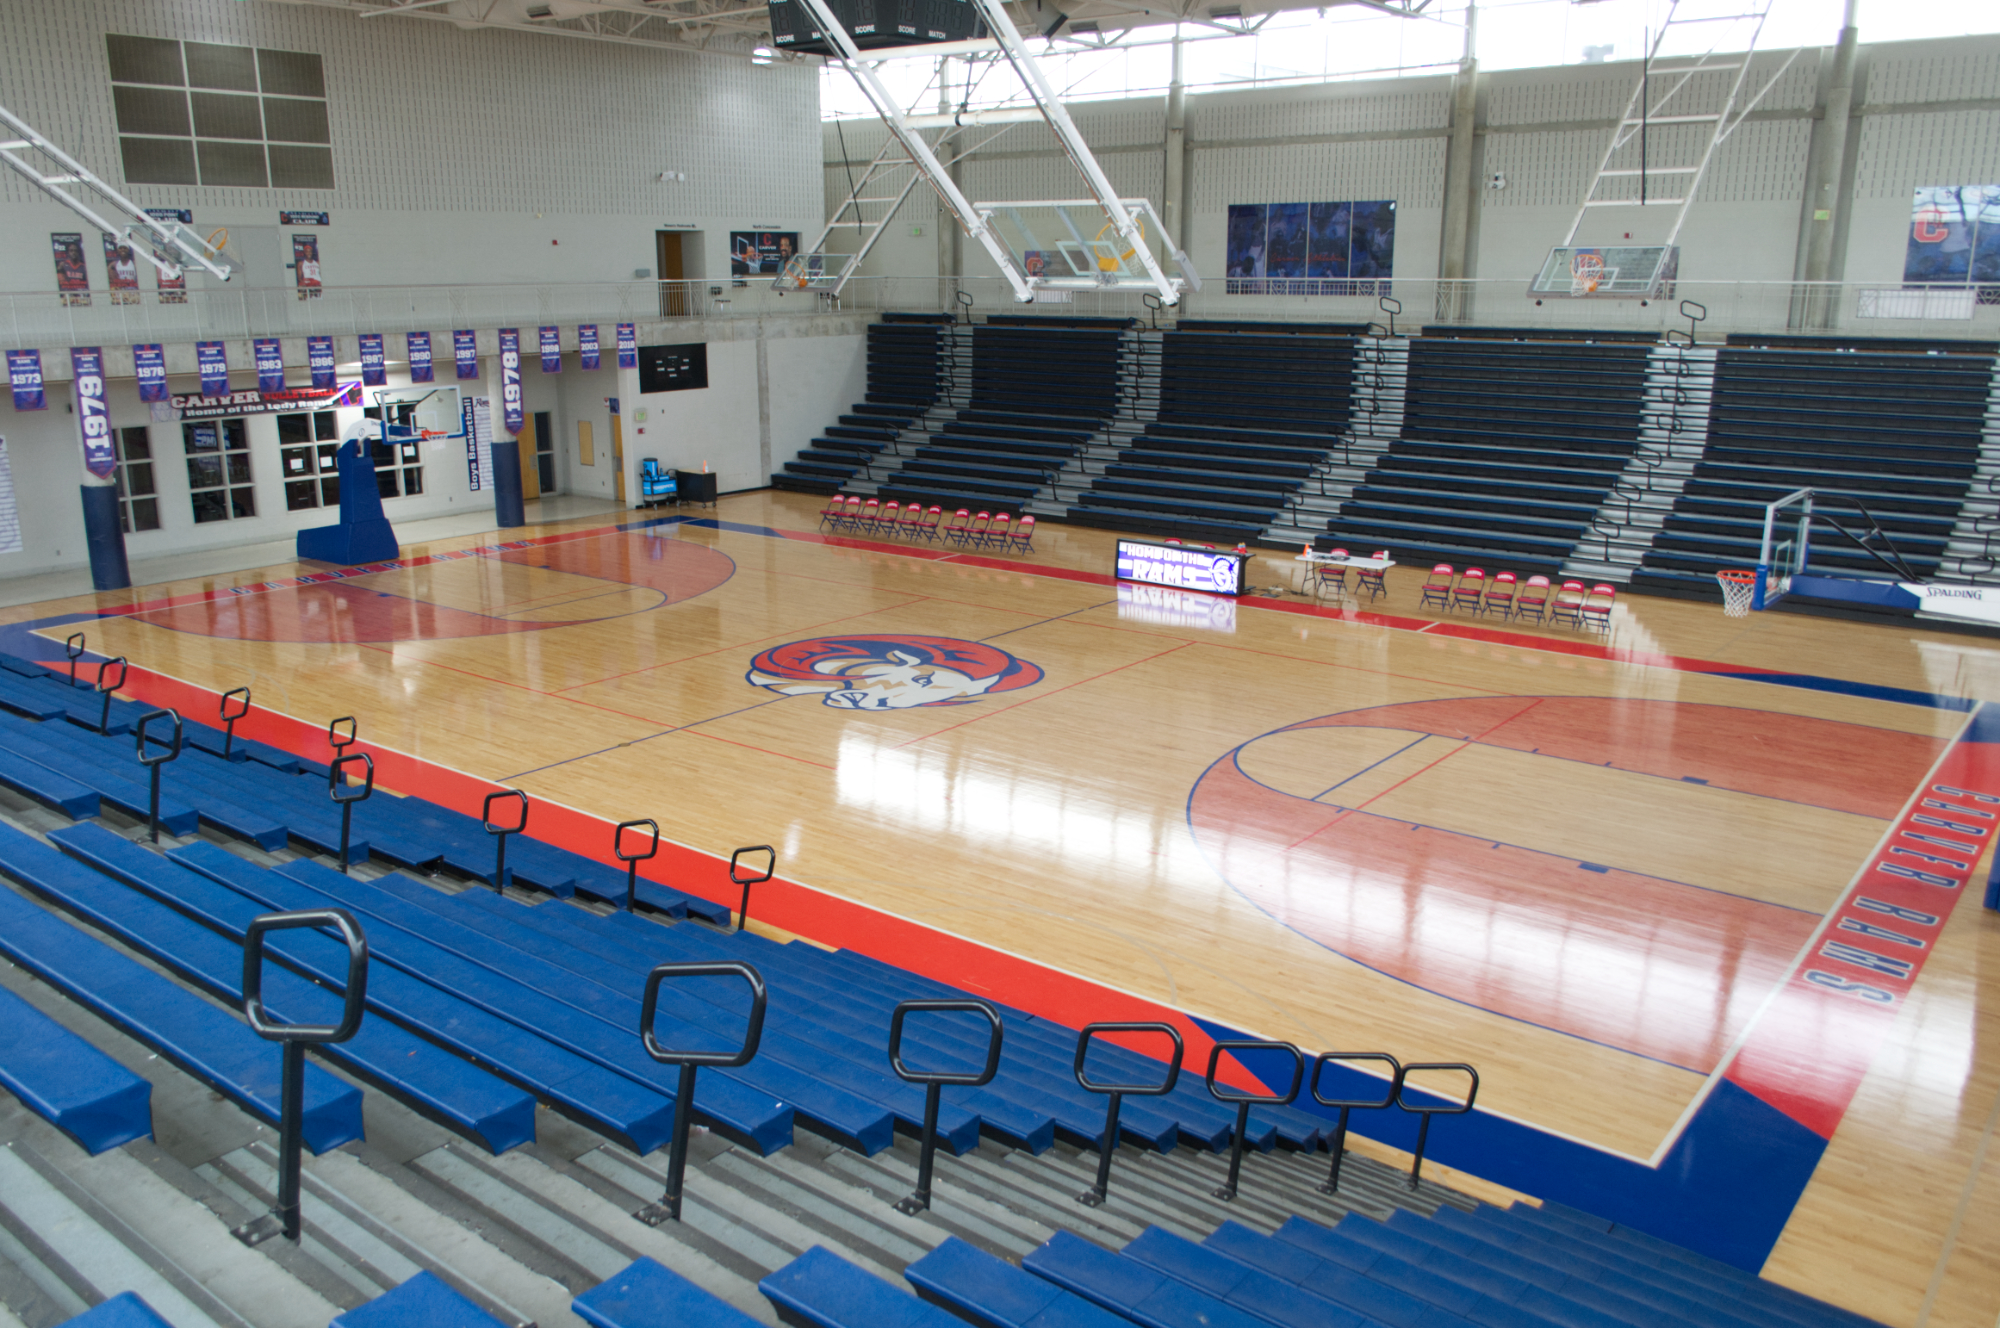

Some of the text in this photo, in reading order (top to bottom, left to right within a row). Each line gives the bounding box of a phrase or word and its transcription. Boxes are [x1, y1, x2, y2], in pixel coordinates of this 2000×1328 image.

[812, 30, 832, 39] MAH
[855, 24, 875, 34] SCORE
[898, 25, 916, 35] SCORE
[928, 30, 946, 39] MATCH
[776, 34, 795, 43] SCORE
[580, 342, 599, 351] 2003
[409, 351, 431, 361] 1990
[456, 349, 476, 359] 1997
[200, 362, 227, 374] 1979
[257, 359, 282, 370] 1983
[137, 366, 165, 378] 1978
[12, 373, 42, 385] 1973
[502, 351, 522, 411] 1978
[171, 391, 261, 409] CARVER
[79, 376, 111, 449] 1979
[186, 408, 226, 417] Home
[228, 406, 241, 414] of
[243, 404, 265, 412] the
[267, 402, 297, 410] Lady
[463, 398, 479, 490] Boys Basketball
[1127, 544, 1163, 560] HOME
[228, 540, 538, 595] CARVER RAMS
[1133, 559, 1197, 586] RAMS
[1926, 587, 1982, 600] SPALDING
[1803, 784, 2000, 1003] CARVER RAMS
